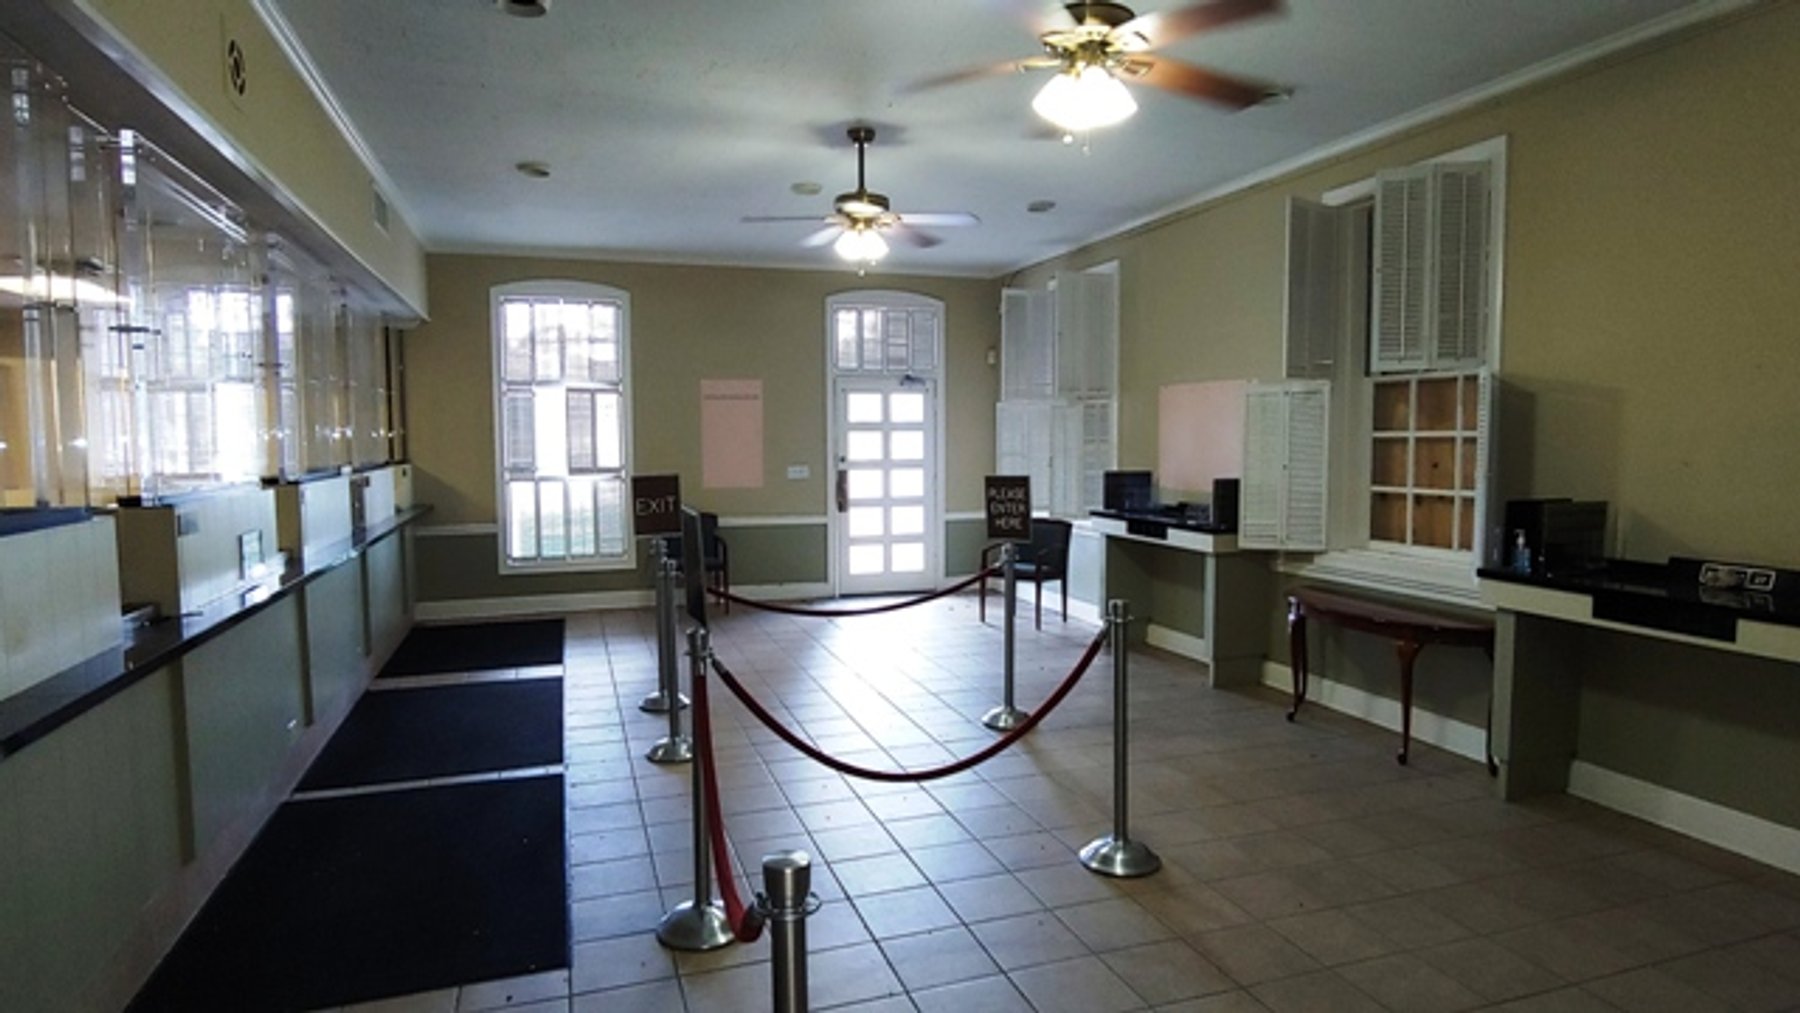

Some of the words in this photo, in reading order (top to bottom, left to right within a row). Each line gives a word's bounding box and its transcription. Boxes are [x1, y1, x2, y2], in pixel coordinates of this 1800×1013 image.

[988, 486, 1026, 500] PLEASE
[635, 495, 677, 516] EXIT
[989, 501, 1027, 515] ENTER
[994, 515, 1024, 530] HERE
